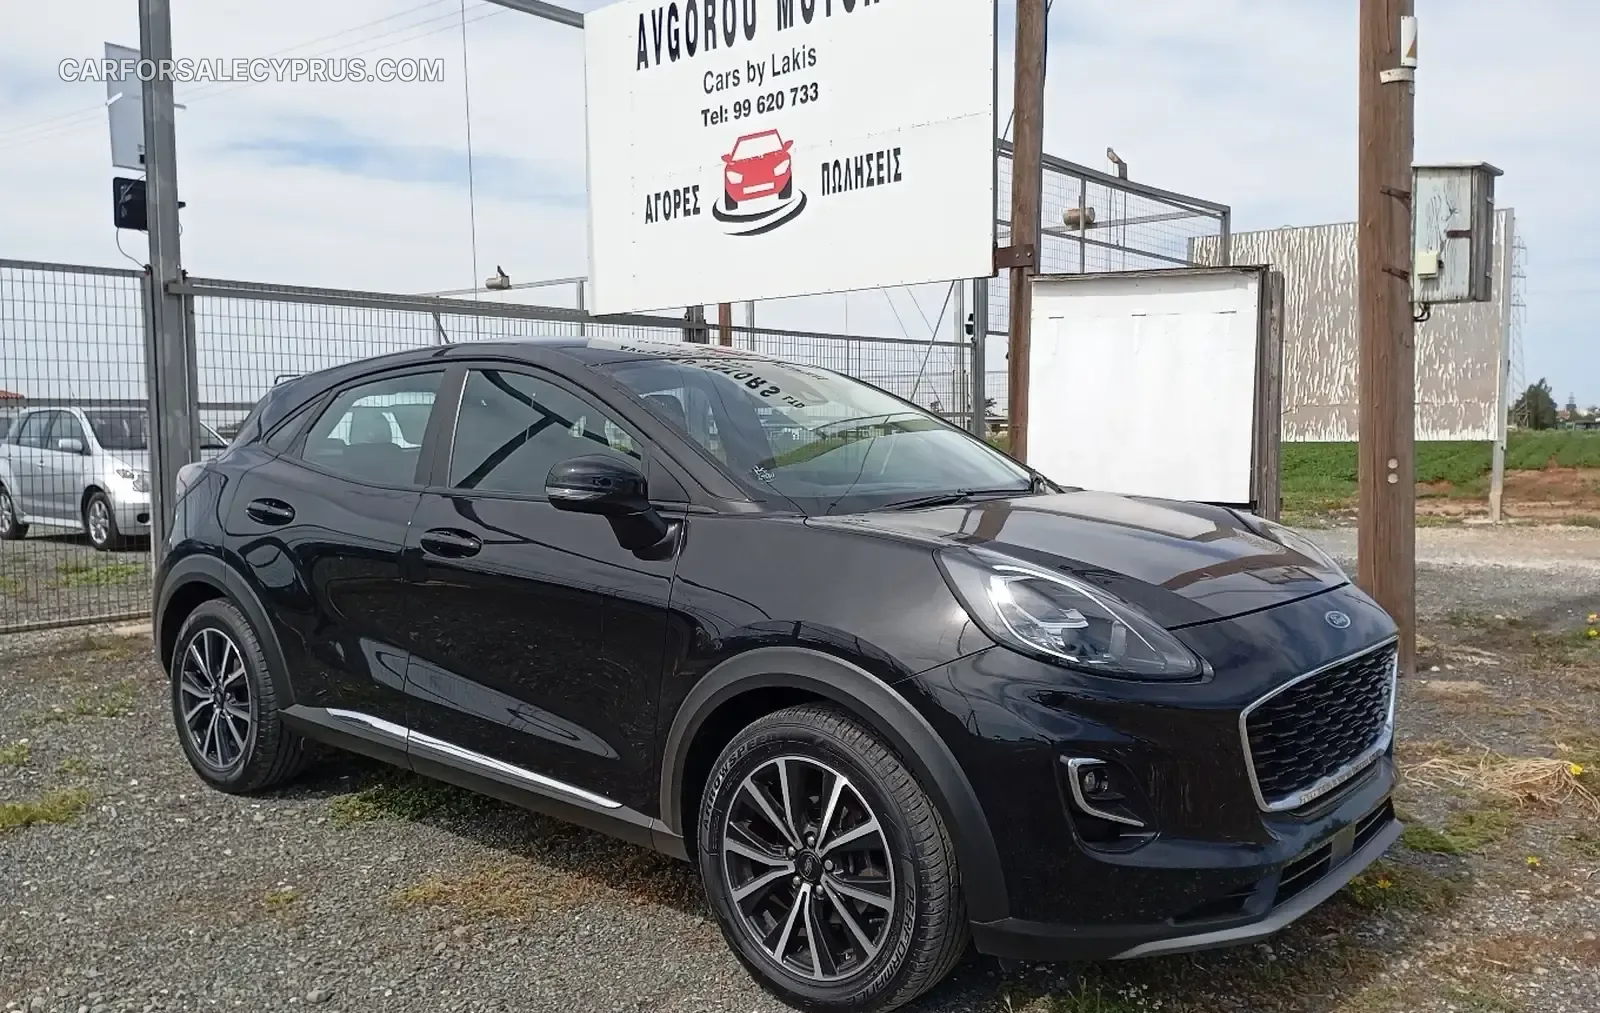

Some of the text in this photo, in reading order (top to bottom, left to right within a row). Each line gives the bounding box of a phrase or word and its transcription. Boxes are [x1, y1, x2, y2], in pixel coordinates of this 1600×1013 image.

[637, 0, 757, 71] AVGOROU
[703, 45, 817, 94] Cars by Lakis
[701, 82, 819, 127] Tel: 99 620 733
[821, 147, 902, 196] ΠΩΛΗΣΕΙΣ
[645, 184, 701, 224] ΑΓΟΡΕΣ
